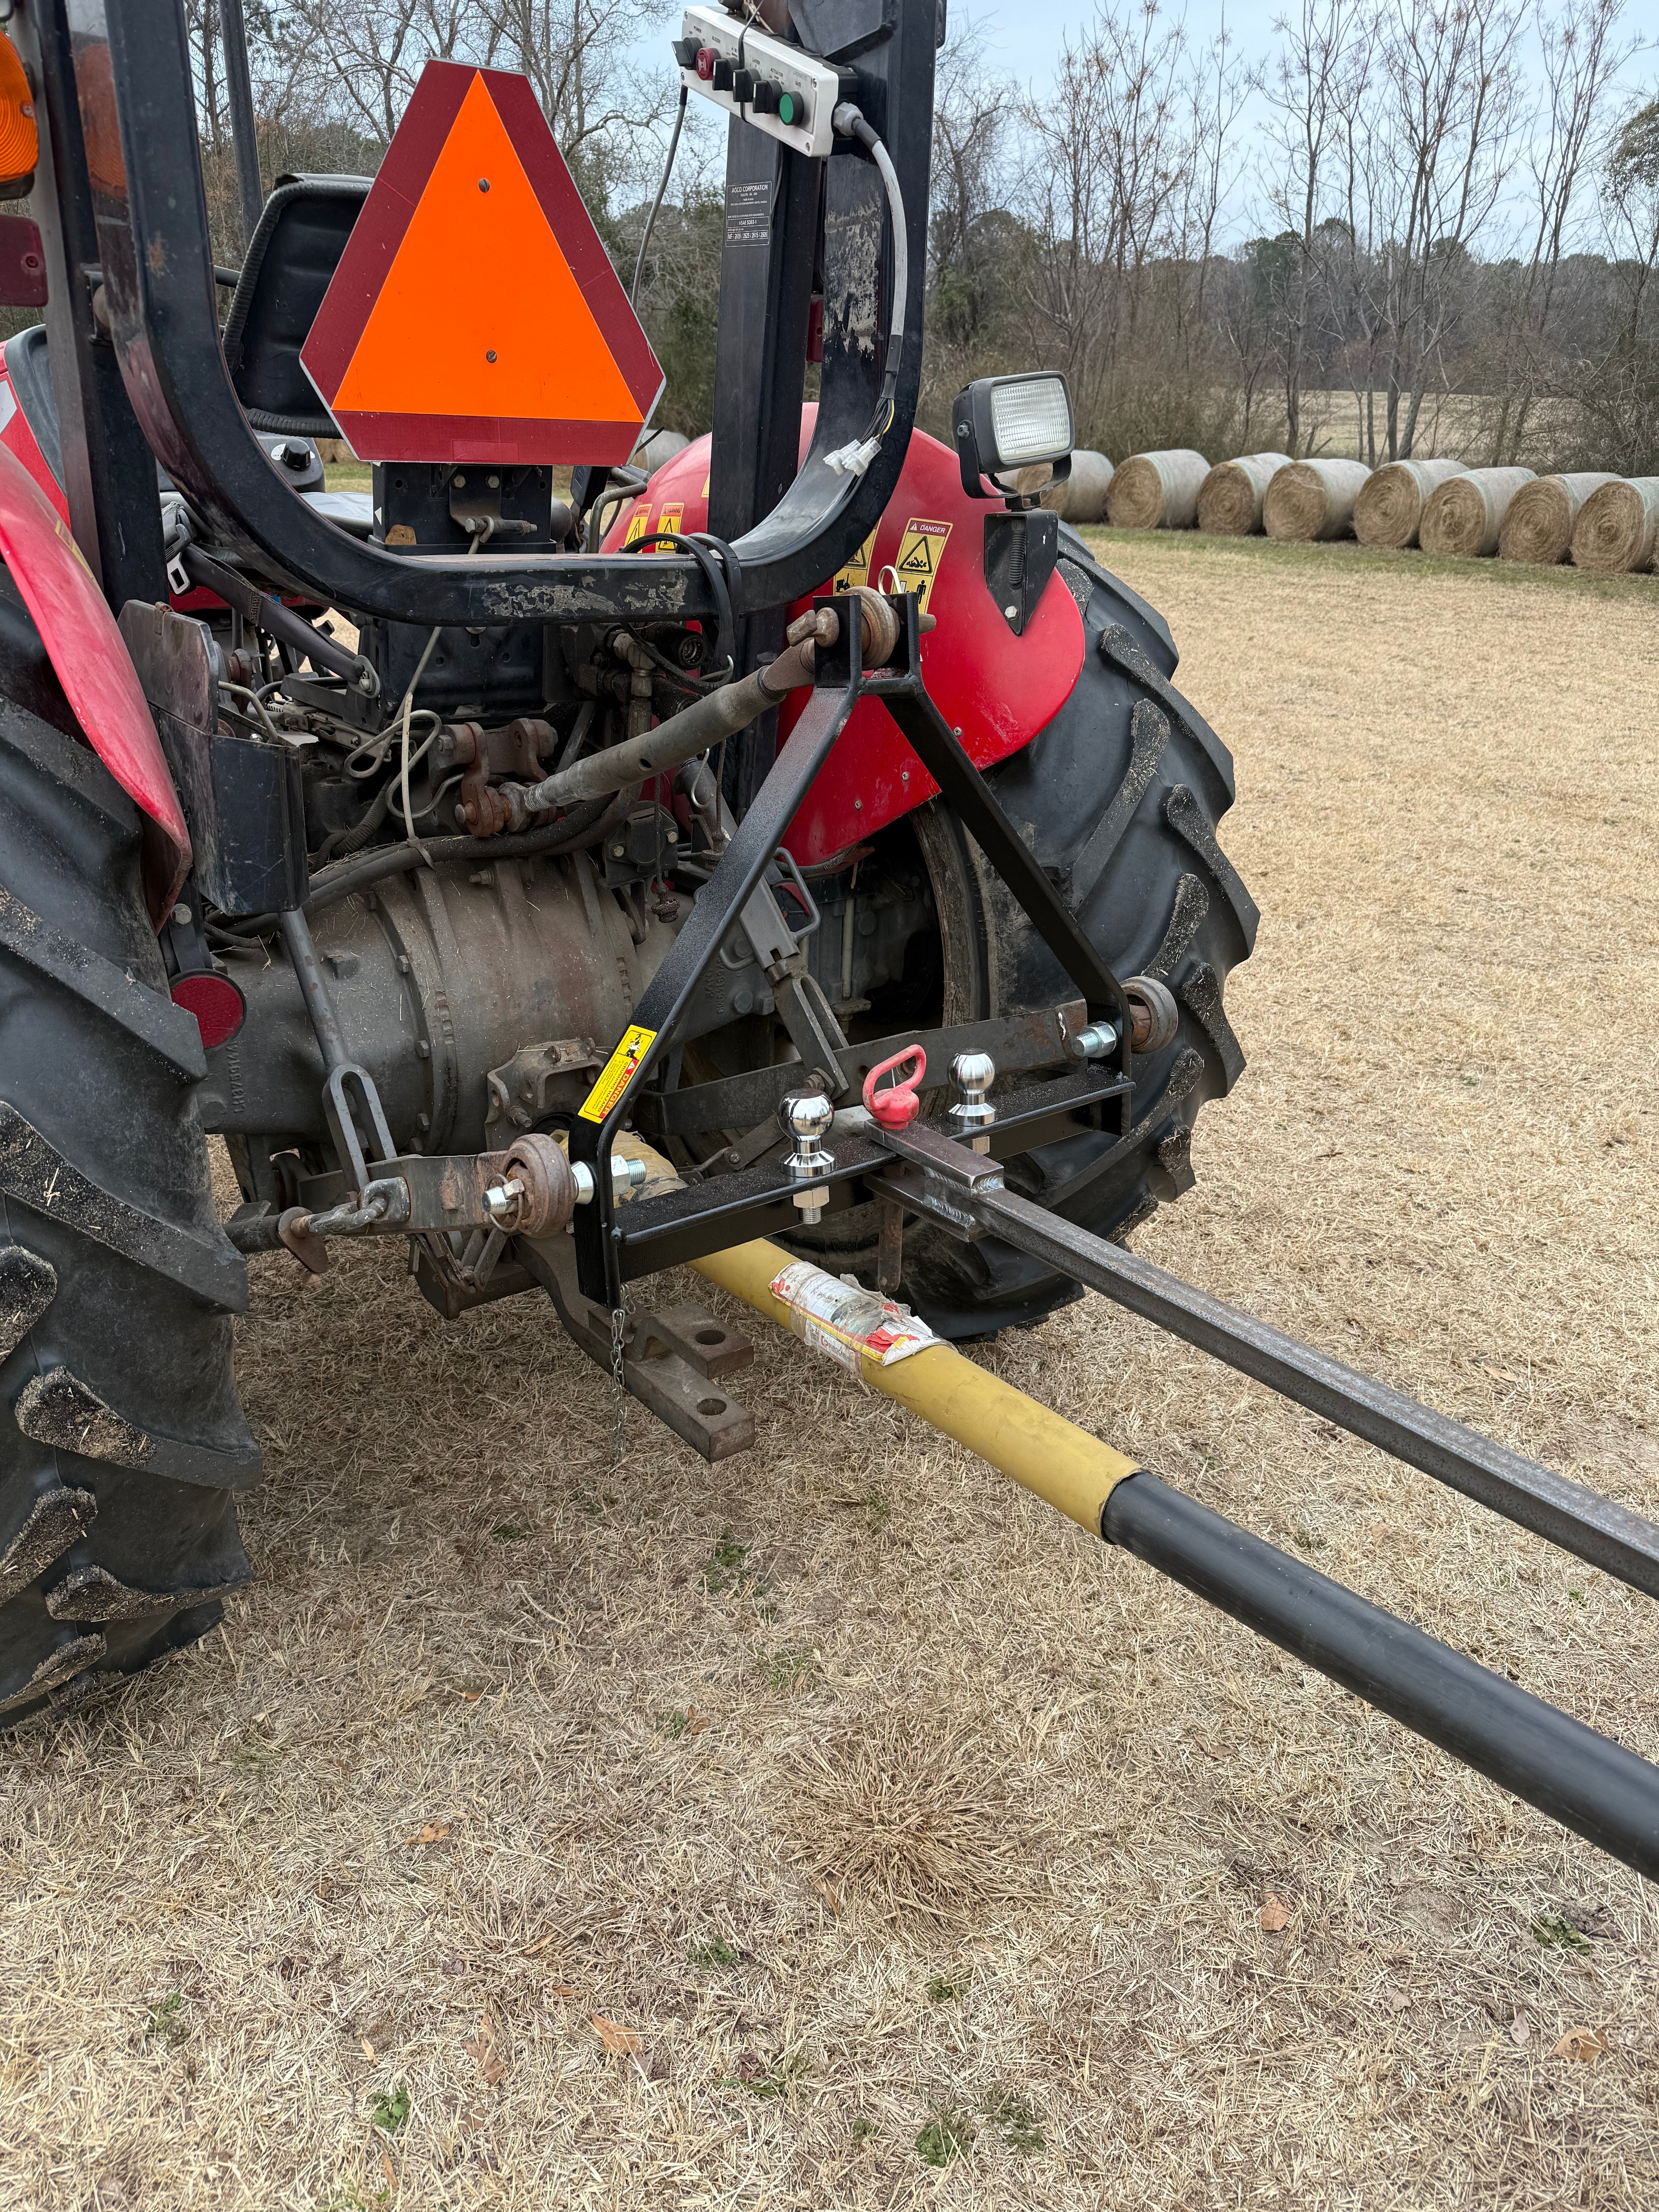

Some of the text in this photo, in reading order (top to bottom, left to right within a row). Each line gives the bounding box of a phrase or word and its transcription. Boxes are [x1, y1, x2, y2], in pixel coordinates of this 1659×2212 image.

[770, 67, 783, 77] ACTUATOR
[920, 524, 945, 534] DANGER
[597, 1062, 628, 1112] CRUSHING HAZARD
[604, 1073, 629, 1115] DANGER
